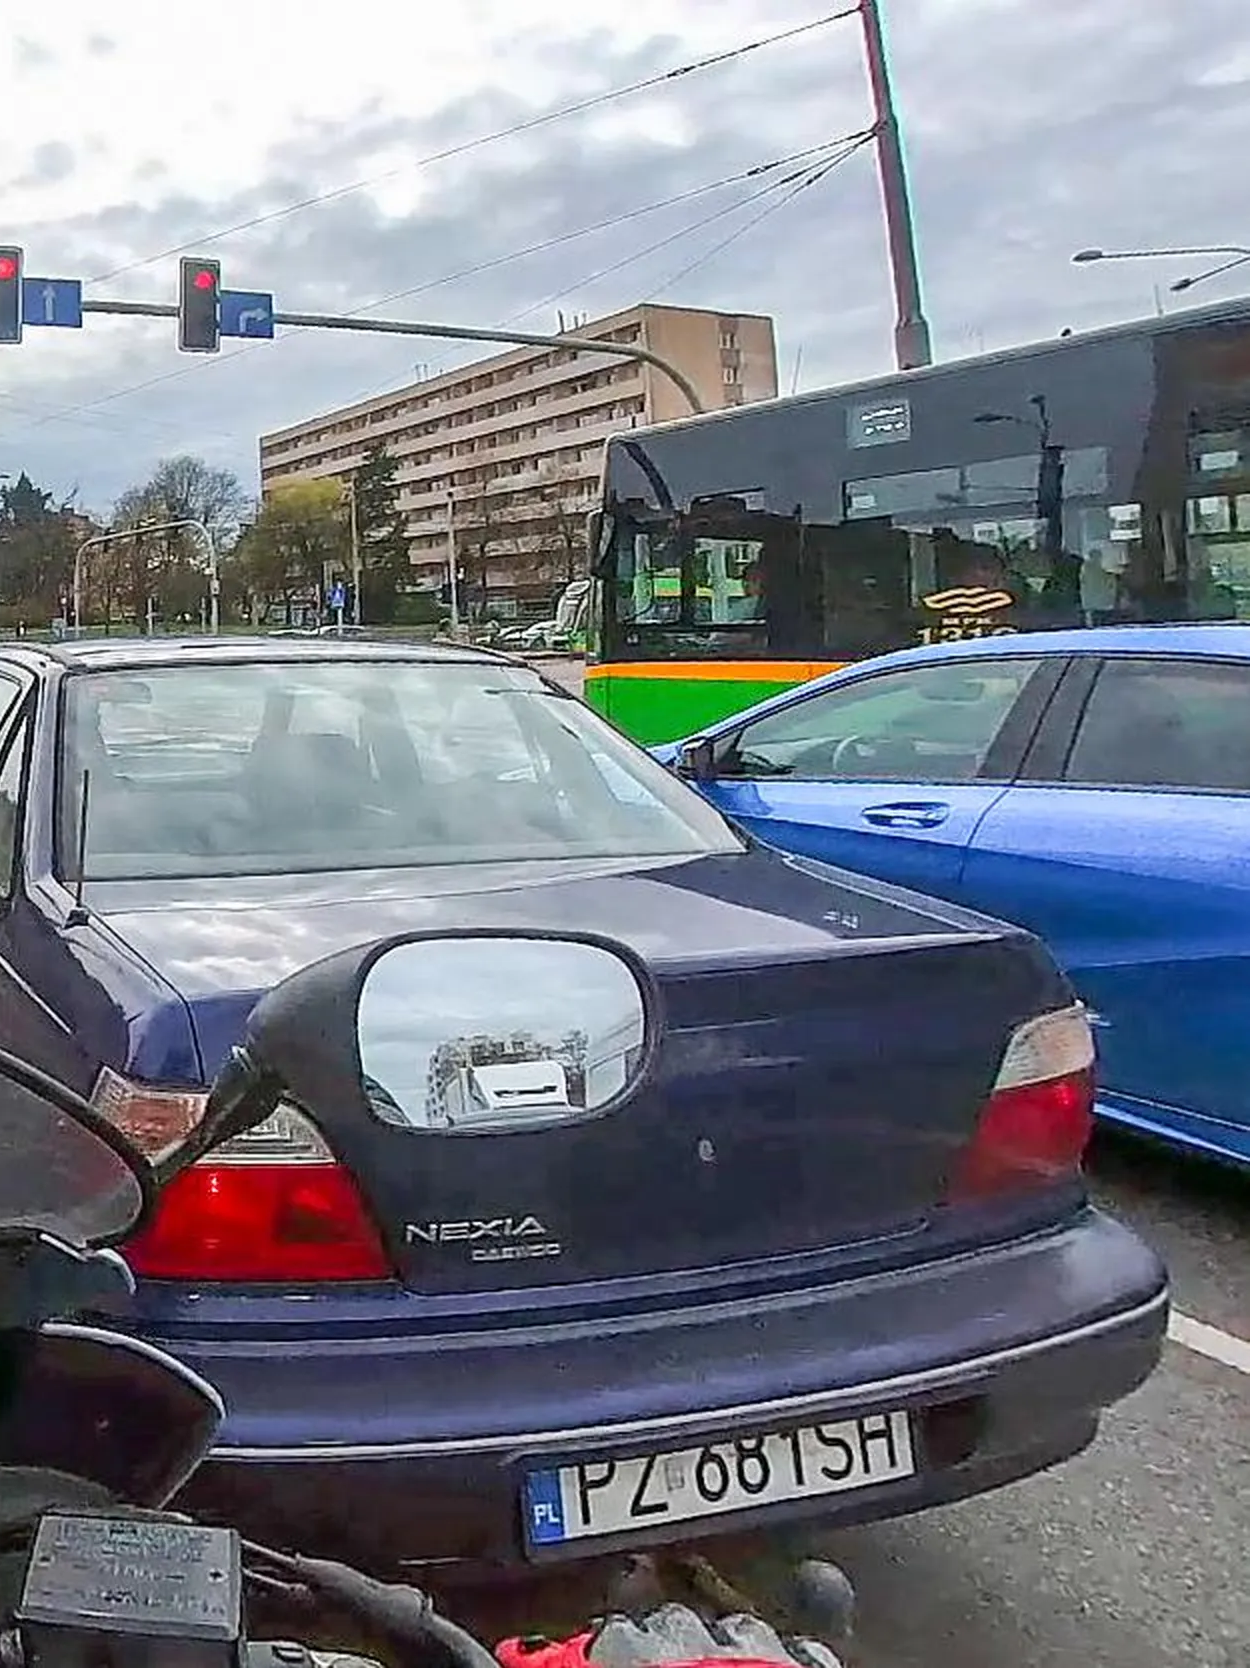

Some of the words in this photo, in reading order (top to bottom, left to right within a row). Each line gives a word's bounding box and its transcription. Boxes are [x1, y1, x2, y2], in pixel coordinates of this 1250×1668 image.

[406, 1216, 546, 1242] NEXIA
[577, 1454, 668, 1524] PZ
[695, 1413, 896, 1502] 681SH
[534, 1504, 560, 1525] PL
